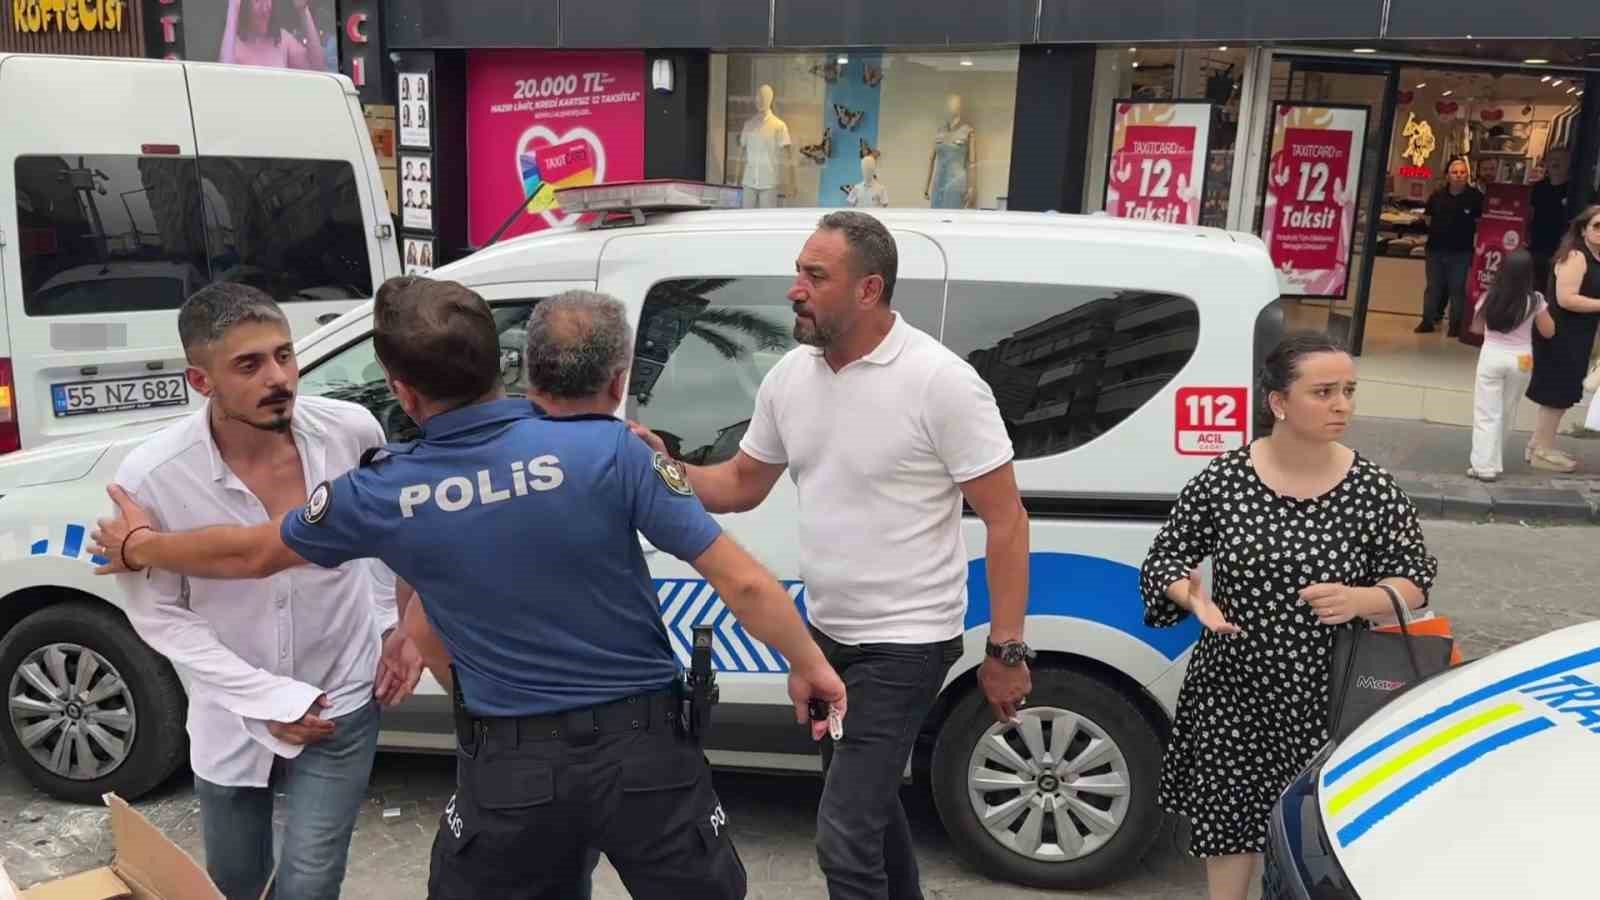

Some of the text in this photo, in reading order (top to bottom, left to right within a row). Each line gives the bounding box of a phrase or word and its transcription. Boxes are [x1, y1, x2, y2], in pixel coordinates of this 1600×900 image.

[513, 74, 577, 99] 20.000
[582, 72, 605, 92] TL
[1139, 158, 1172, 197] 12
[1296, 162, 1329, 202] 12
[1125, 200, 1180, 224] Taksit
[1281, 205, 1336, 229] Taksit
[1485, 250, 1501, 271] 12
[67, 386, 96, 407] 55
[105, 383, 138, 404] NZ
[142, 379, 182, 400] 682
[1185, 395, 1237, 426] 112
[1518, 674, 1600, 734] TRA
